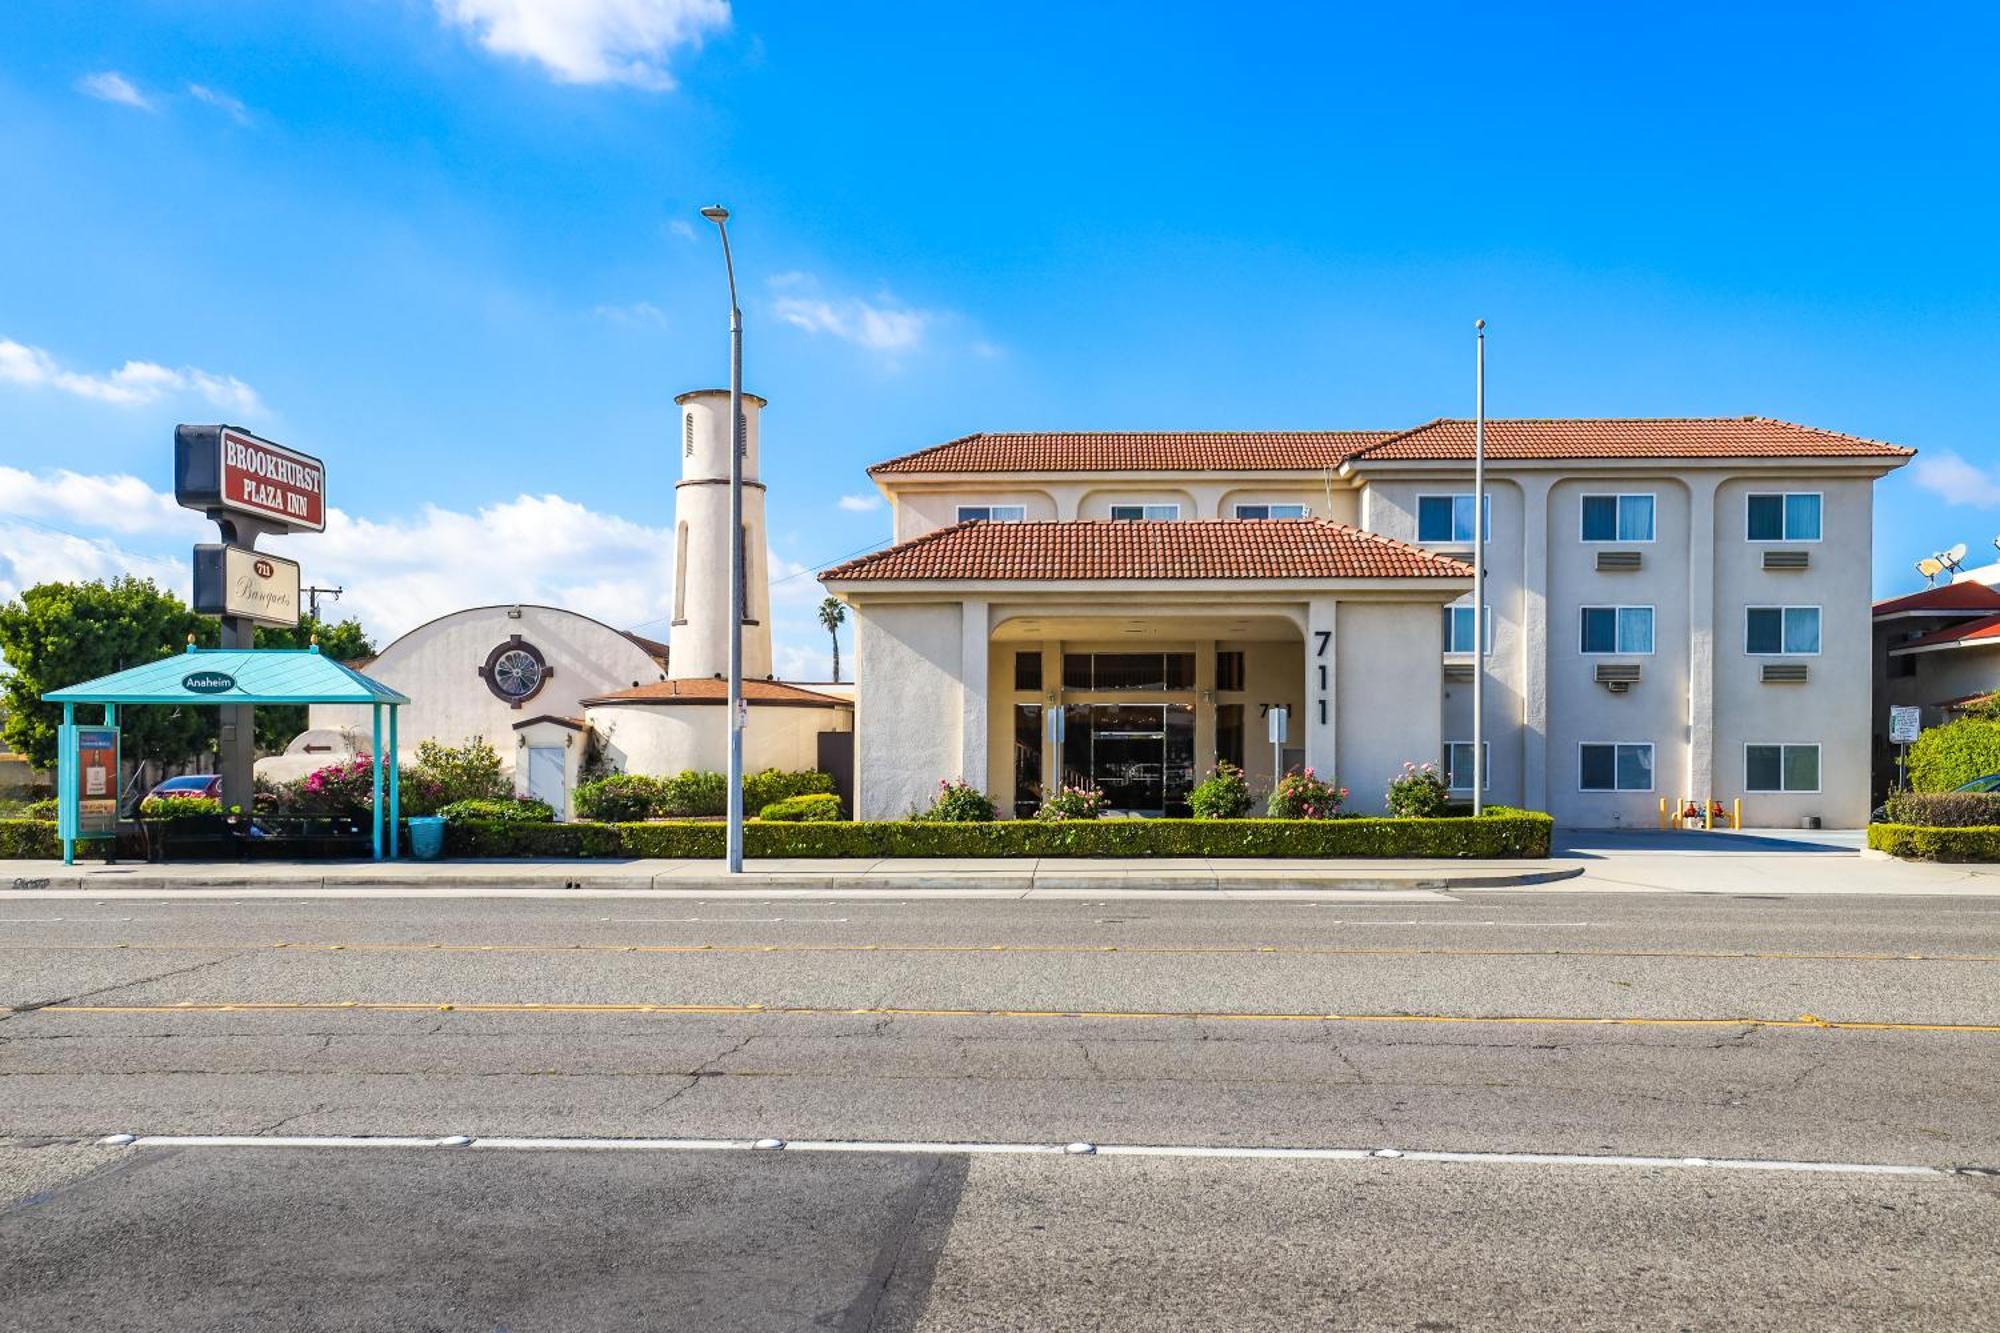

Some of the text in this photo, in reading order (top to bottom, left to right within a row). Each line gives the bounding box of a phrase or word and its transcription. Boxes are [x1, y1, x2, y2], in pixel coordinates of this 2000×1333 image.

[226, 439, 320, 493] BROOKHURST
[243, 478, 308, 517] PLAZA INN
[256, 562, 271, 577] 711
[186, 676, 231, 688] Anaheim
